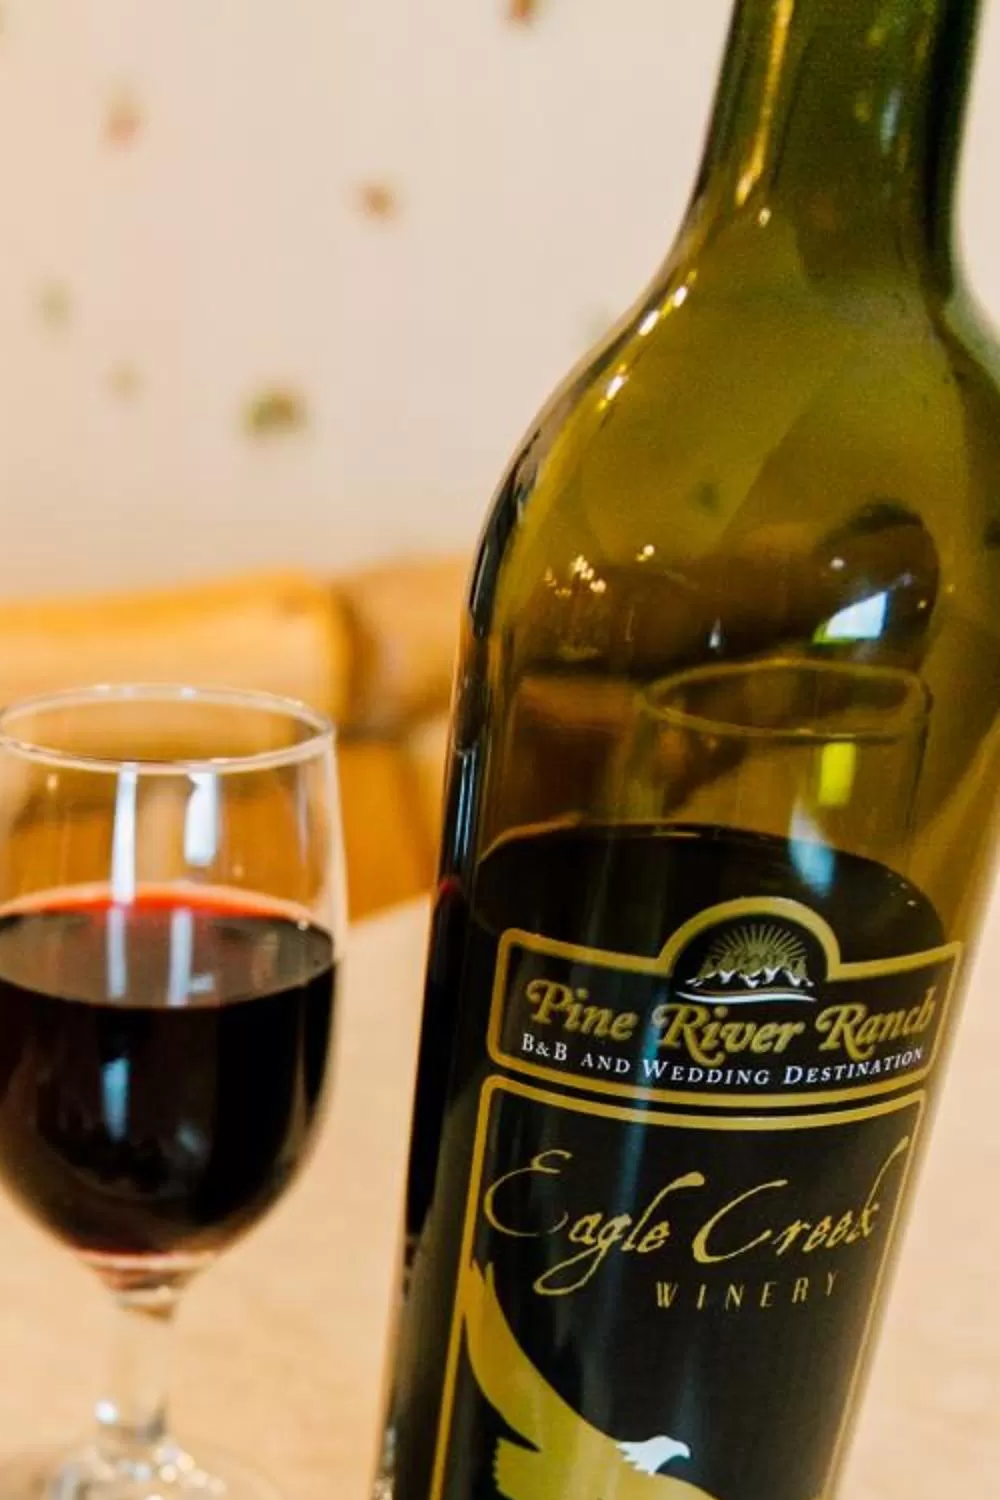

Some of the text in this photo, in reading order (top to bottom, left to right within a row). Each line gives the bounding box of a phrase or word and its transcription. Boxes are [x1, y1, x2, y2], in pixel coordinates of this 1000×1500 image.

[527, 979, 937, 1067] Pine River Ranch
[521, 1033, 924, 1086] B&B AND WEDDING DESTINATION
[484, 1136, 909, 1295] Eagle Creek
[657, 1273, 838, 1309] WINERY
